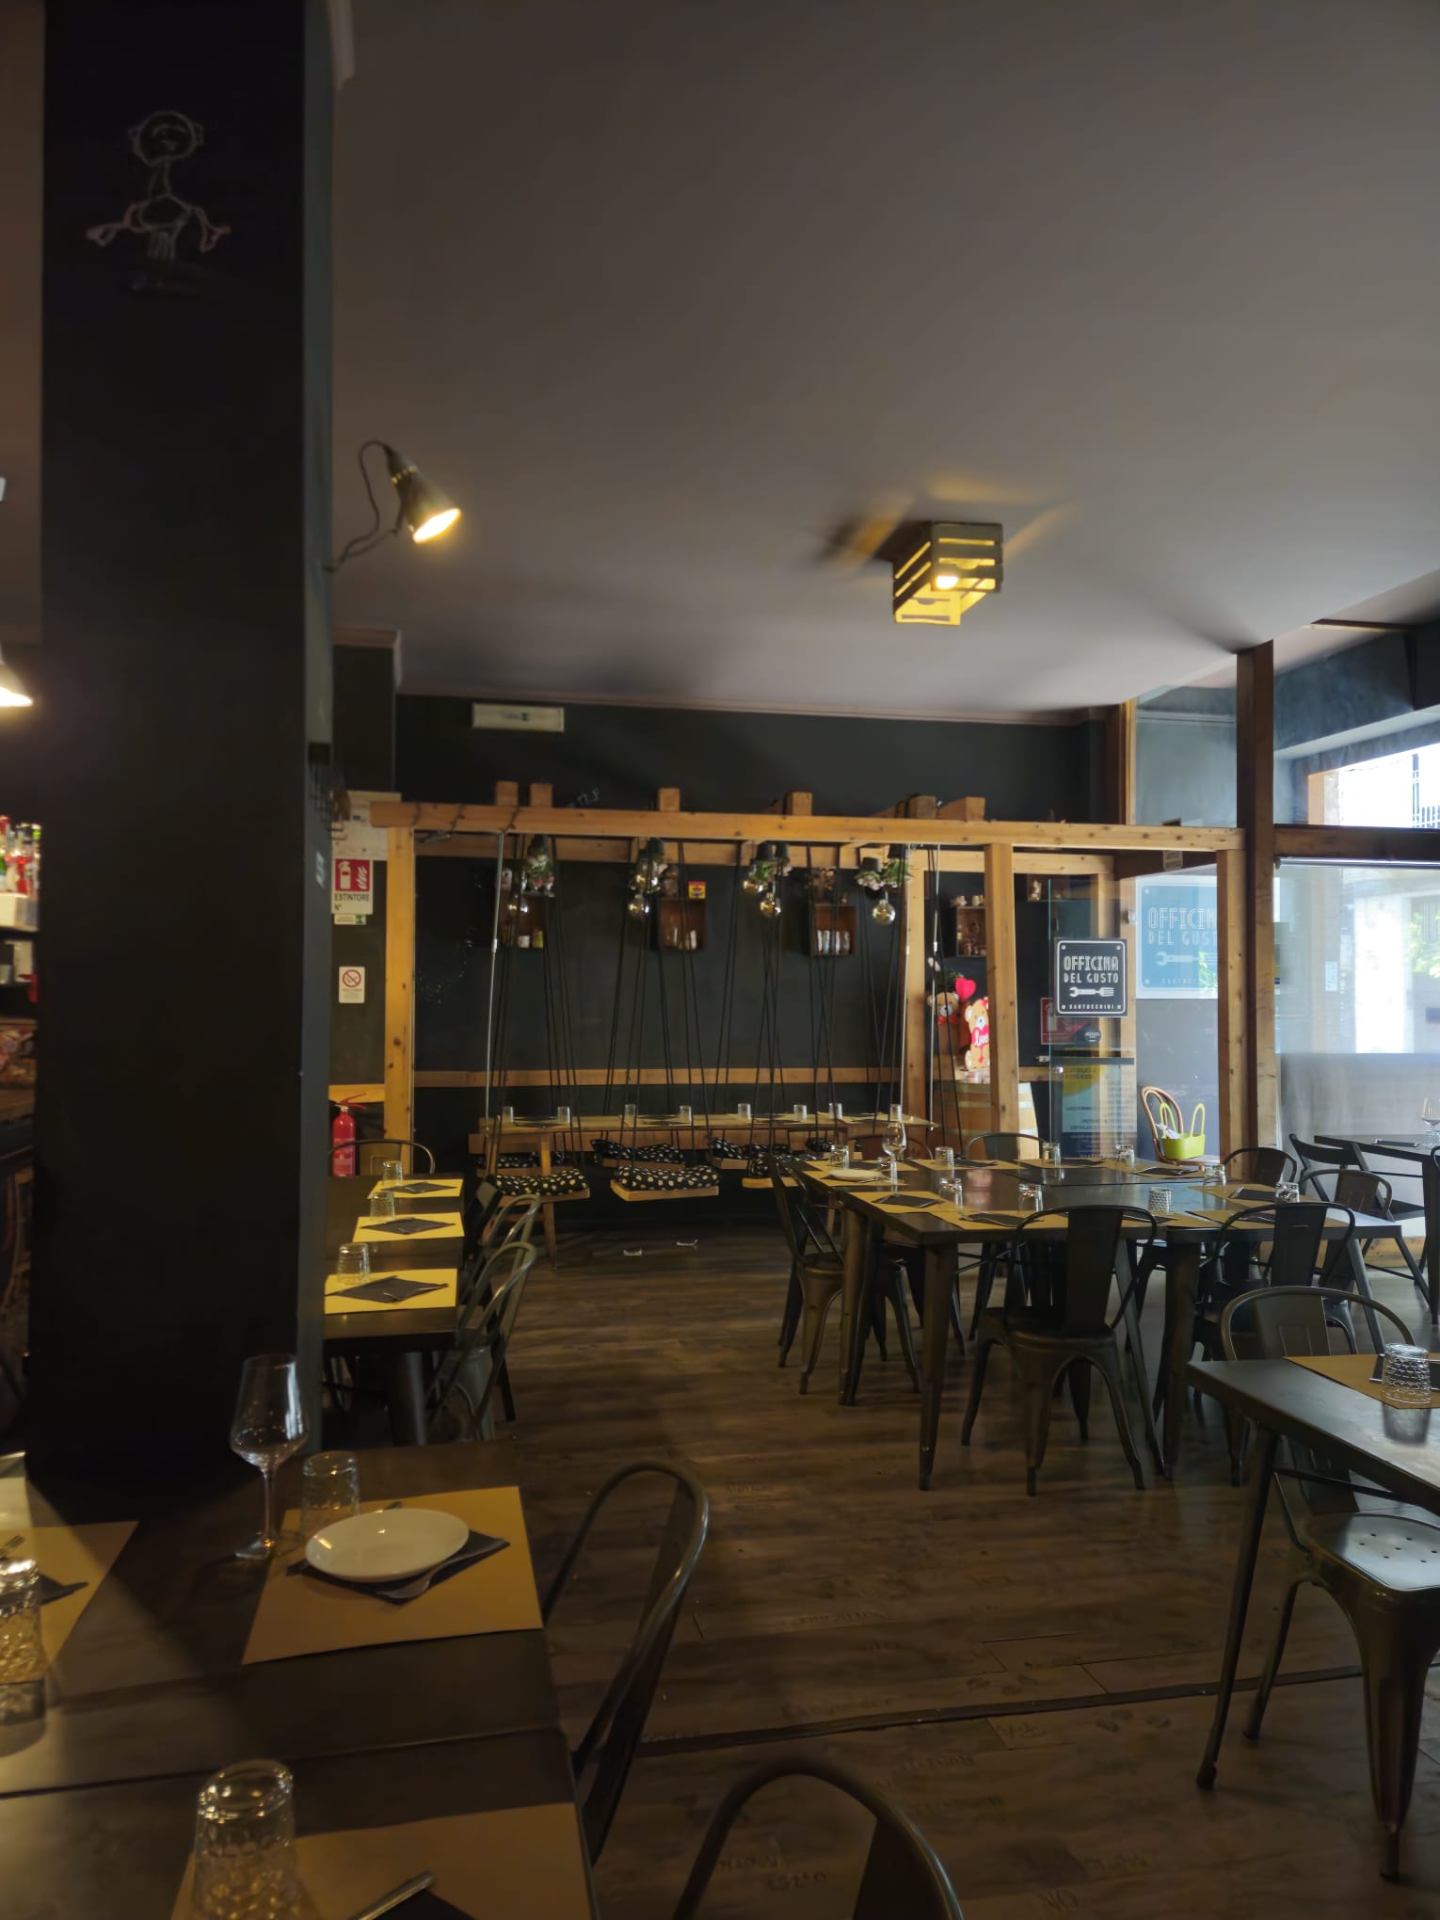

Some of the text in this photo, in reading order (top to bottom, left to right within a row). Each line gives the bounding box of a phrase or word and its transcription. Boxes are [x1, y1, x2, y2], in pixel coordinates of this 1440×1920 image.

[1148, 907, 1217, 930] OFFICIN
[1148, 930, 1217, 945] DEL GUST
[1063, 955, 1119, 971] OFFICINA
[1063, 972, 1119, 983] DEL GUSTO
